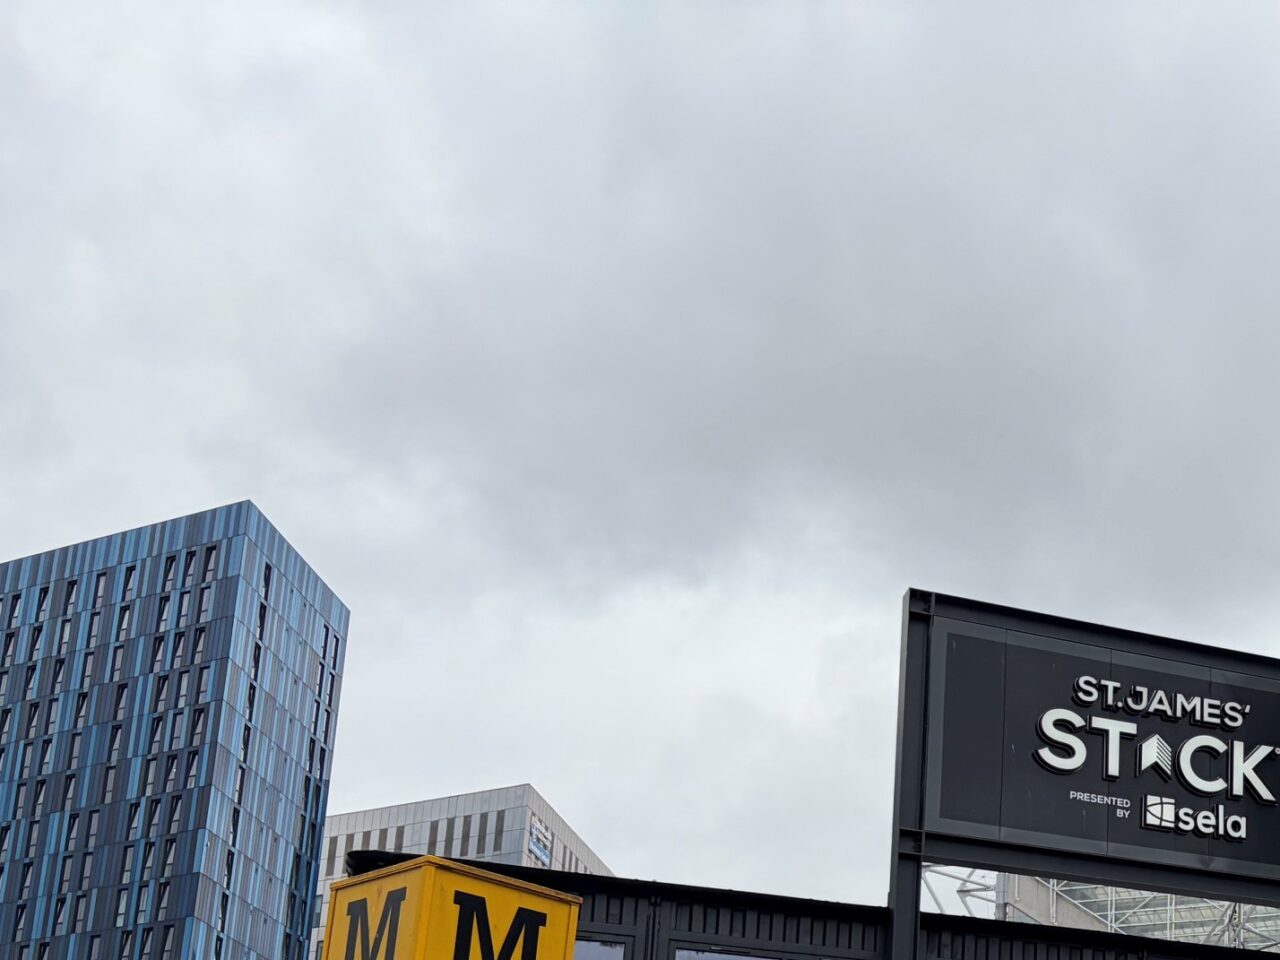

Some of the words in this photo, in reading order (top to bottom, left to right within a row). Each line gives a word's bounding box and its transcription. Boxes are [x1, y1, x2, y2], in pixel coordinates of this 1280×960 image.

[1069, 790, 1131, 808] PRESENTED
[1116, 808, 1131, 818] BY
[1177, 804, 1247, 839] sela
